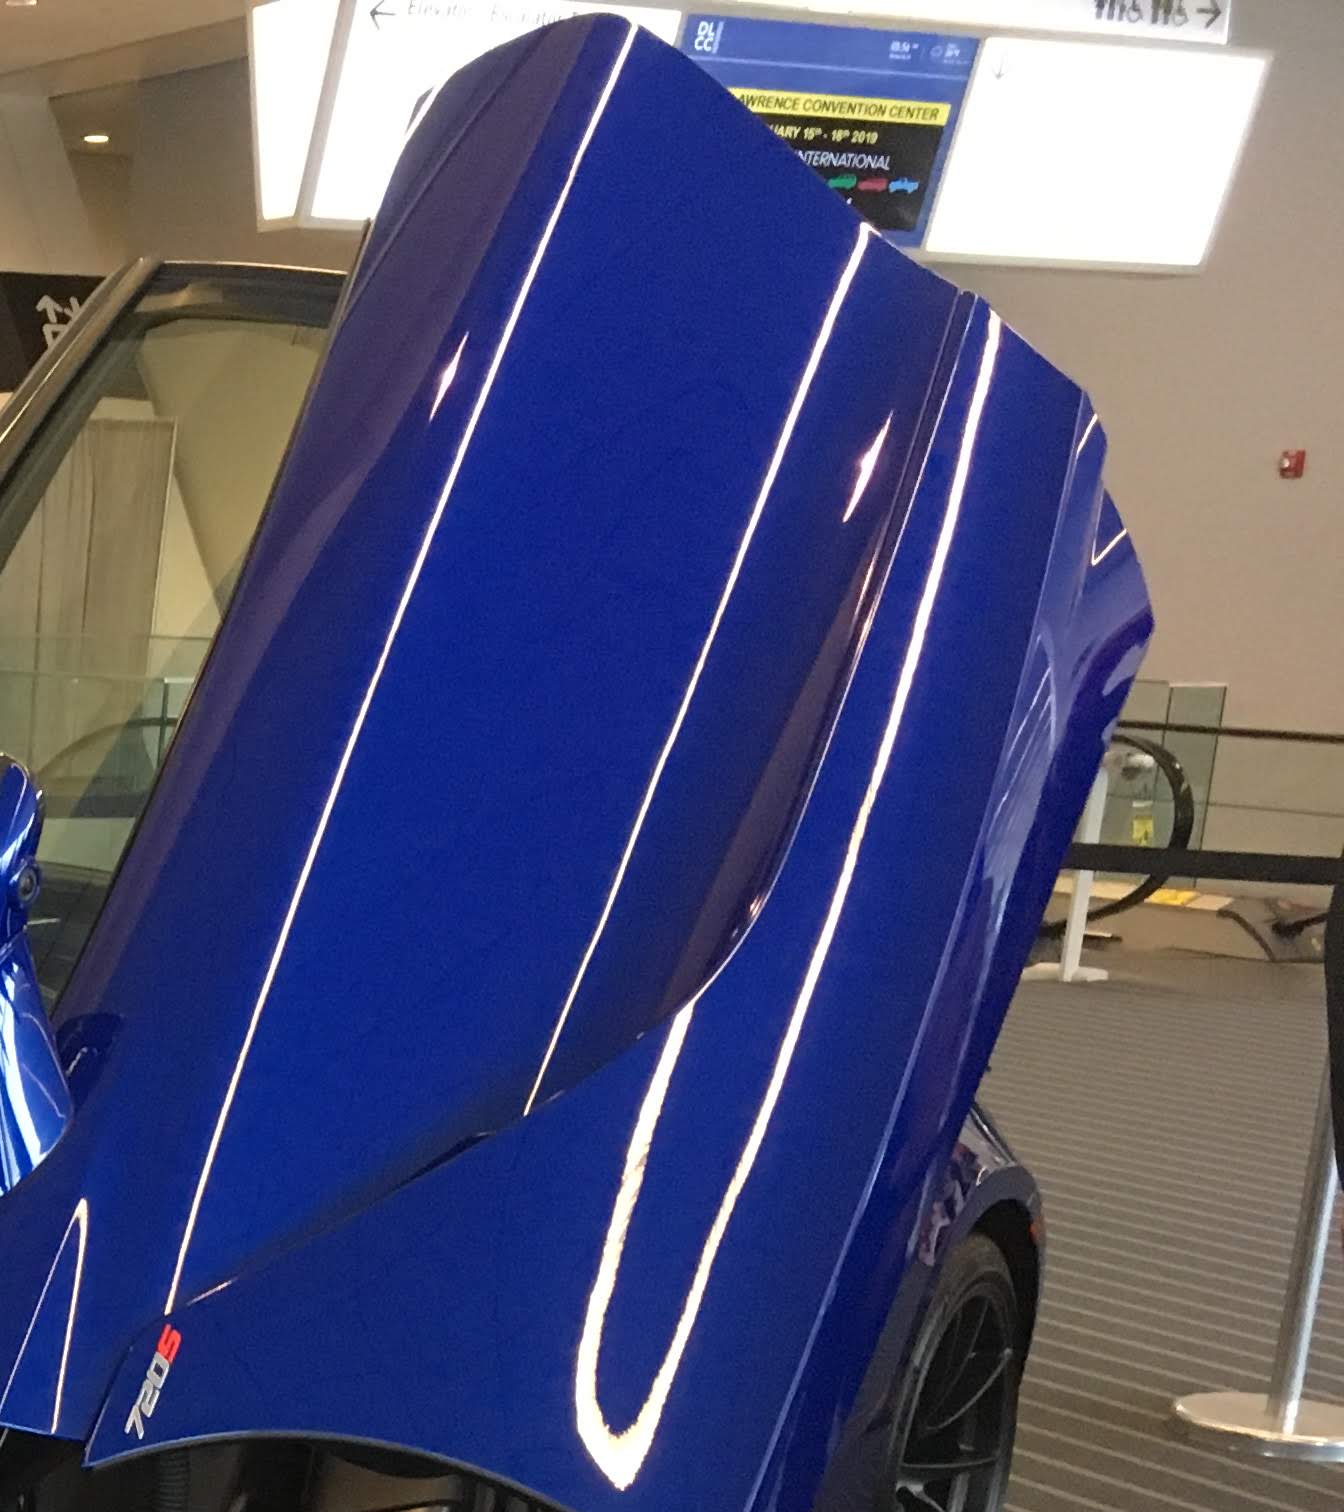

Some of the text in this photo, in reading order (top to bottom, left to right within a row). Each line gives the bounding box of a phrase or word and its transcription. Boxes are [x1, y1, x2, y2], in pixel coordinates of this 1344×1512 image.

[803, 97, 886, 116] CONVENTION
[888, 101, 939, 121] CENTER
[851, 130, 878, 145] 2019
[796, 150, 890, 171] NTERNATIONAL
[124, 1323, 182, 1440] 720S
